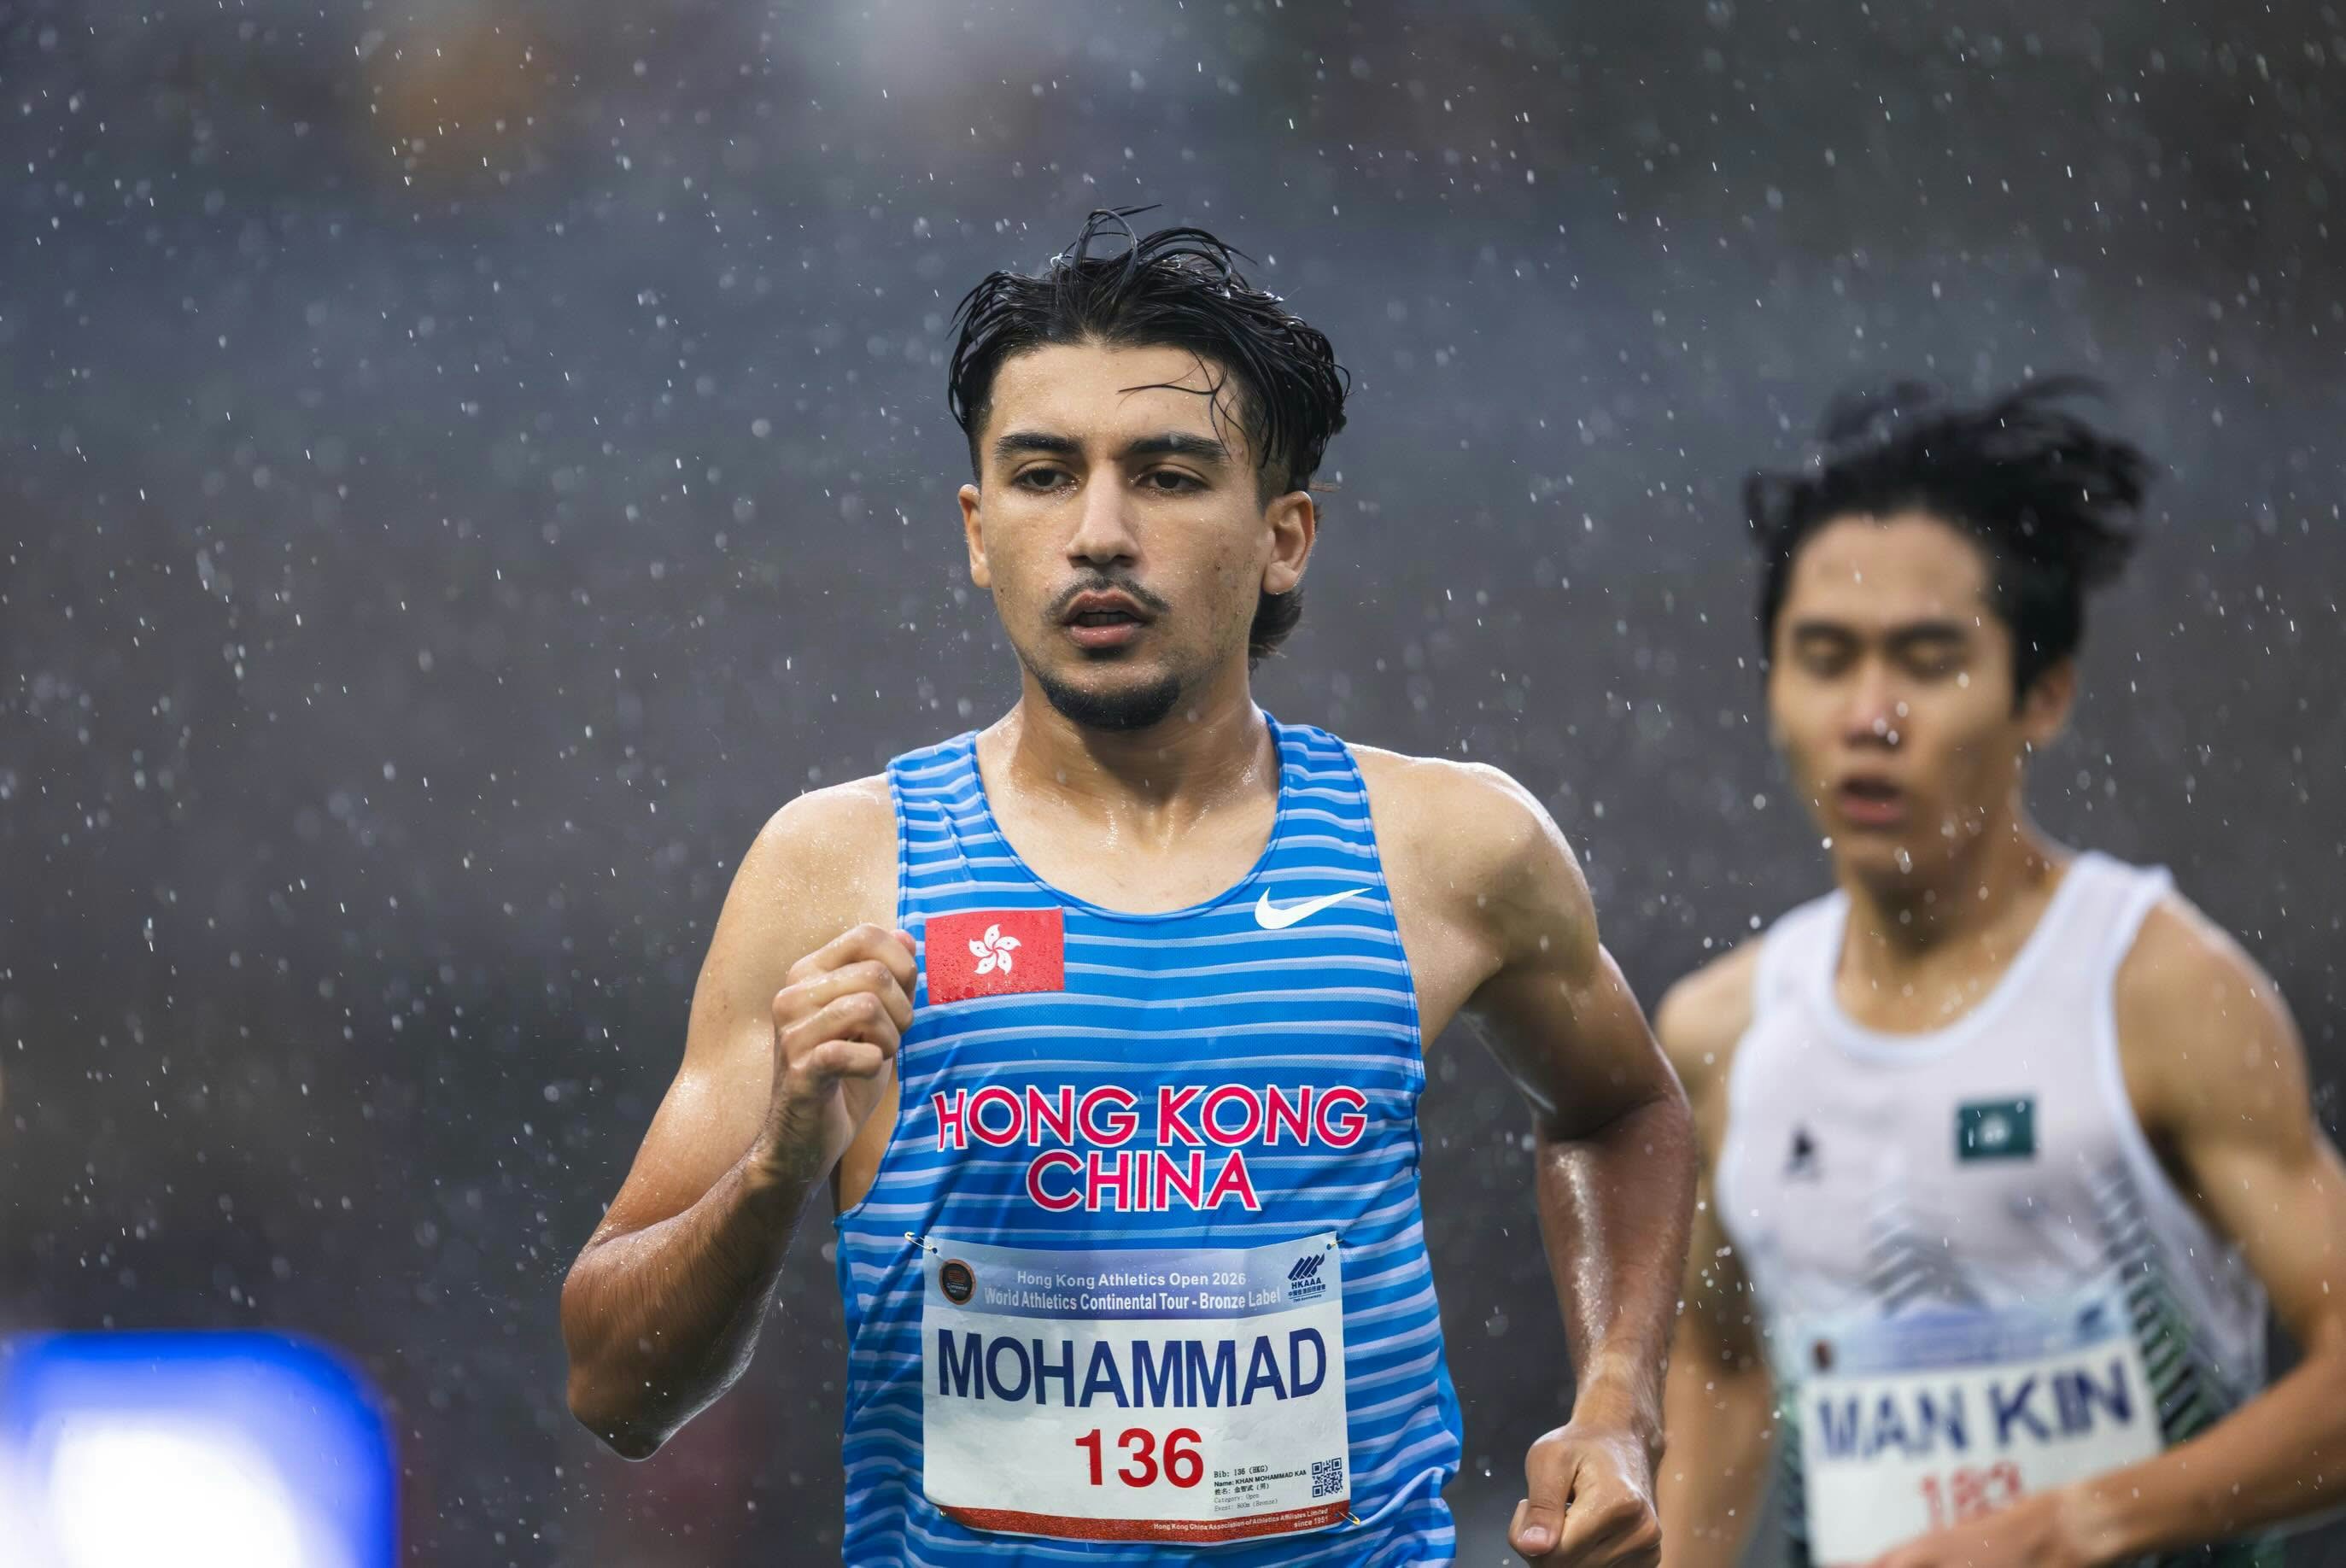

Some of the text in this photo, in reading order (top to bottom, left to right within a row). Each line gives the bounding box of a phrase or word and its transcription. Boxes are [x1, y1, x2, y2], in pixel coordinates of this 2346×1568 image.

[932, 1084, 1368, 1152] HONG KONG
[1025, 1149, 1261, 1212] CHINA
[984, 1287, 1019, 1307] World
[1021, 1290, 1078, 1310] Athletics
[1080, 1293, 1156, 1311] Continental
[1159, 1293, 1190, 1310] Tour
[1199, 1292, 1245, 1309] Bronze
[1249, 1286, 1281, 1308] Label
[1017, 1271, 1247, 1290] Hong Kong Athletics Open 2026
[1291, 1277, 1322, 1290] HKAAA
[938, 1327, 1327, 1408] MOHAMMAD
[1988, 1358, 2132, 1448] KIN
[1075, 1428, 1205, 1489] 136
[1235, 1477, 1254, 1485] KHAN
[1255, 1471, 1294, 1483] MOHAMMAD
[1208, 1520, 1244, 1530] Association
[1252, 1516, 1279, 1524] Athletics
[1280, 1512, 1307, 1521] Affiliates
[1307, 1507, 1328, 1518] Limited
